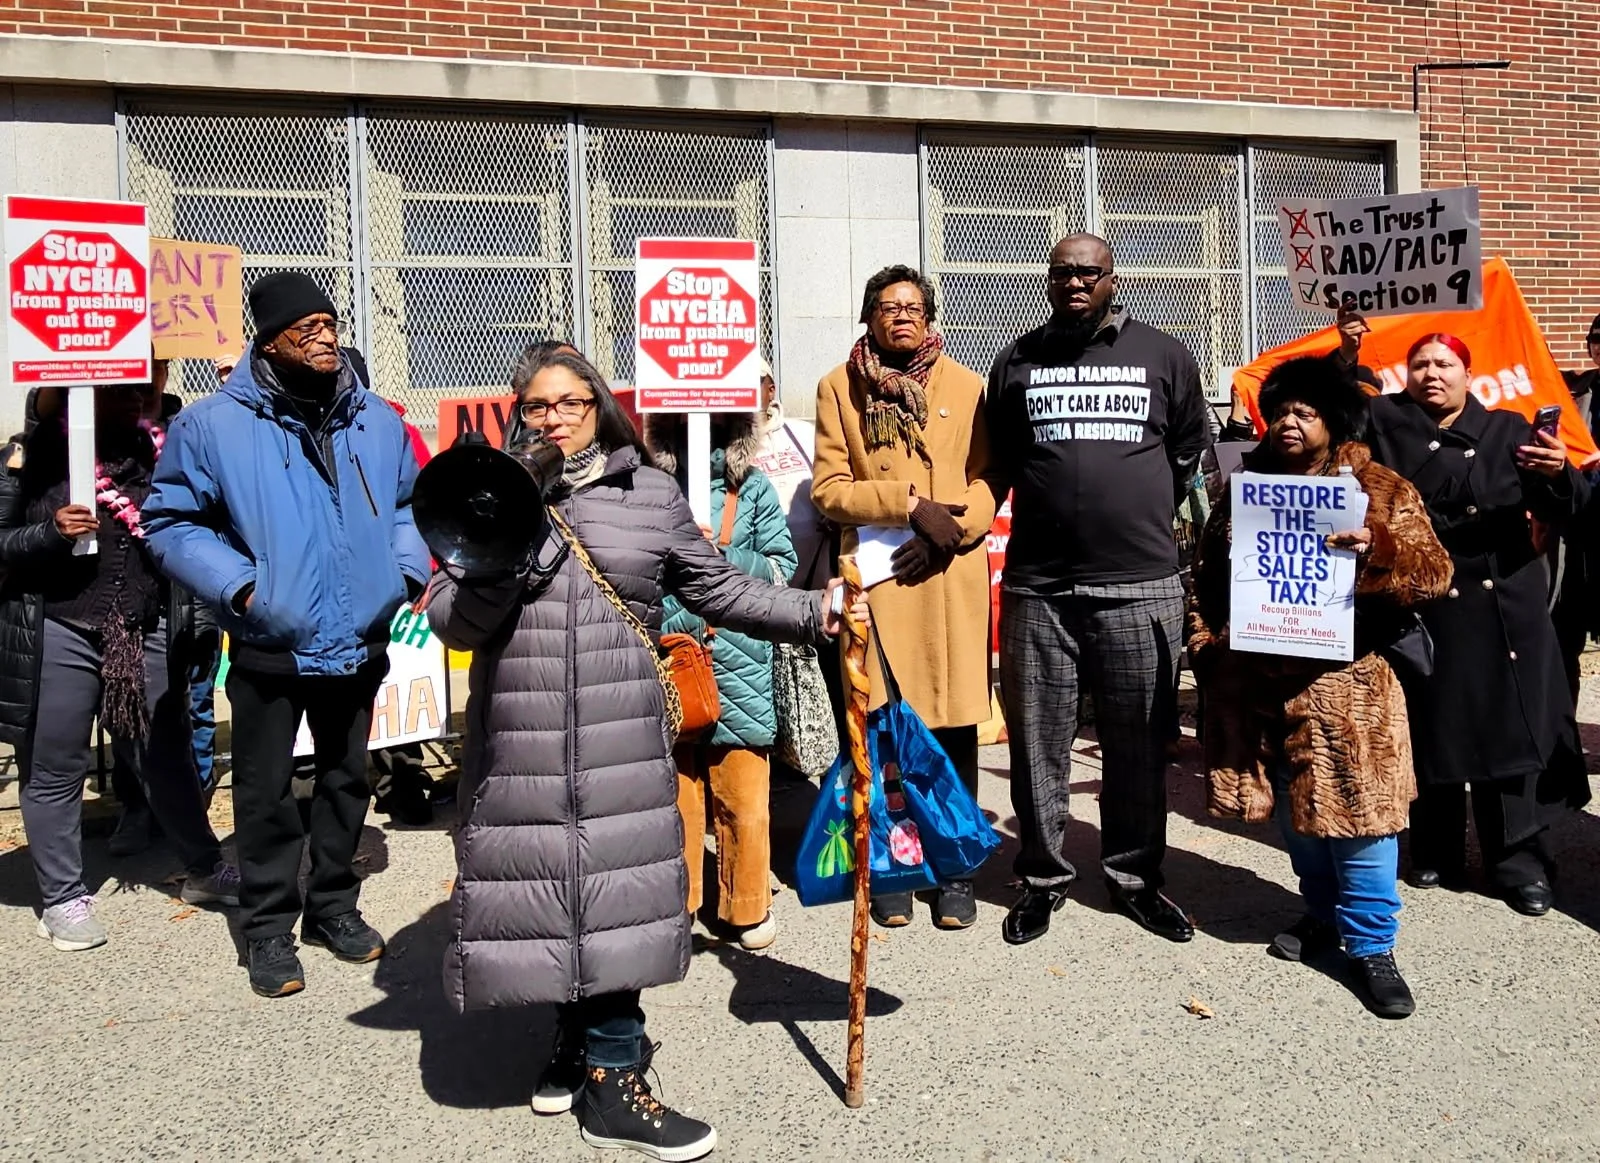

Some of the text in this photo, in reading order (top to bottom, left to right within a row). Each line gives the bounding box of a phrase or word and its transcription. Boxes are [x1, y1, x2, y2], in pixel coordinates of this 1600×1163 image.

[1313, 198, 1446, 237] The Trust
[43, 234, 116, 267] Stop
[1320, 229, 1468, 276] RAD/PACT
[23, 265, 136, 293] NYCHA
[667, 271, 729, 301] Stop
[1323, 269, 1472, 312] Section 9
[12, 291, 145, 314] from pushing
[650, 299, 747, 324] NYCHA
[46, 312, 116, 328] out the
[58, 330, 110, 349] poor!
[640, 324, 756, 344] from pushing
[668, 342, 728, 357] out the
[19, 361, 142, 371] Committee for Independent
[40, 371, 92, 380] Community
[677, 360, 723, 378] poor!
[1030, 366, 1147, 385] MAYOR MAMDANI
[662, 399, 706, 407] Community
[702, 390, 753, 398] Independent
[1028, 394, 1147, 416] DON'T CARE ABOUT
[1033, 422, 1144, 443] NYCHA RESIDENTS
[1242, 483, 1346, 510] RESTORE
[1270, 509, 1316, 532] THE
[1256, 531, 1331, 557] STOCK
[1257, 555, 1329, 582] SALES
[1267, 579, 1317, 606] TAX!
[1261, 604, 1322, 617] Recoup Billions
[1246, 623, 1337, 638] All New Yorkers' Needs
[1283, 617, 1300, 626] FOR
